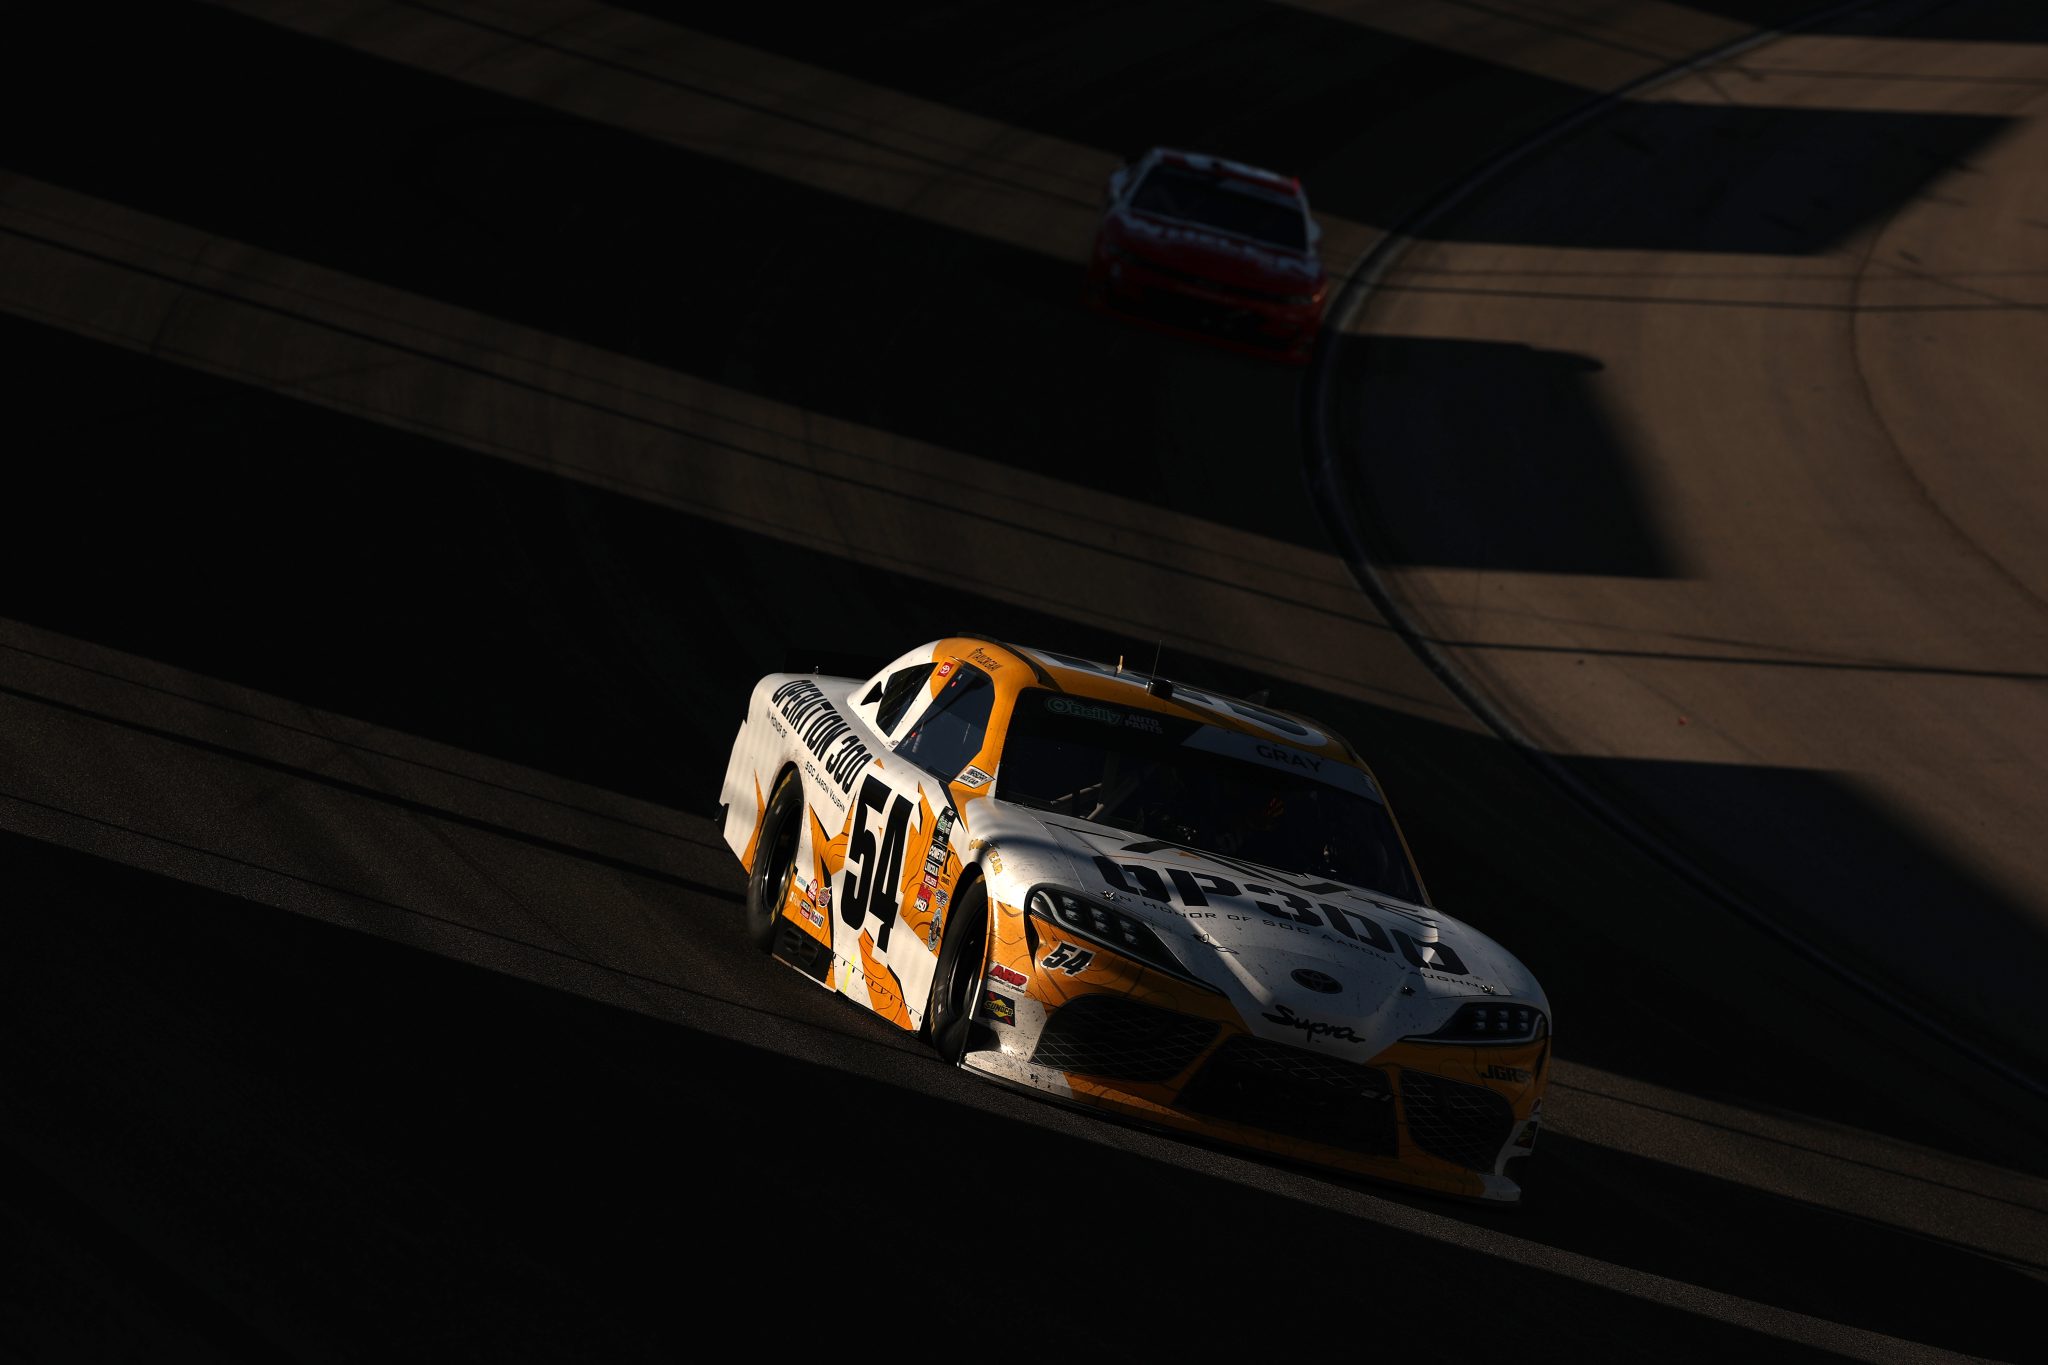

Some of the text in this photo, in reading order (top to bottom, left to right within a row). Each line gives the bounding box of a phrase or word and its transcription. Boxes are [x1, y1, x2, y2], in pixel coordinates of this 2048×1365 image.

[1125, 719, 1163, 735] PARTS
[1129, 714, 1159, 726] AUTO
[772, 679, 873, 794] OPERATION 300
[1256, 744, 1322, 772] GRAY
[841, 773, 914, 953] 54
[914, 898, 928, 912] MSD
[1092, 855, 1469, 976] OP300
[1040, 940, 1096, 976] 54
[1143, 901, 1216, 919] HONOR
[1321, 933, 1387, 962] AARON
[1391, 958, 1482, 989] VAUGHN
[990, 965, 1028, 986] ARP
[984, 1001, 1014, 1016] SUNOCO
[1262, 1004, 1365, 1043] Supra
